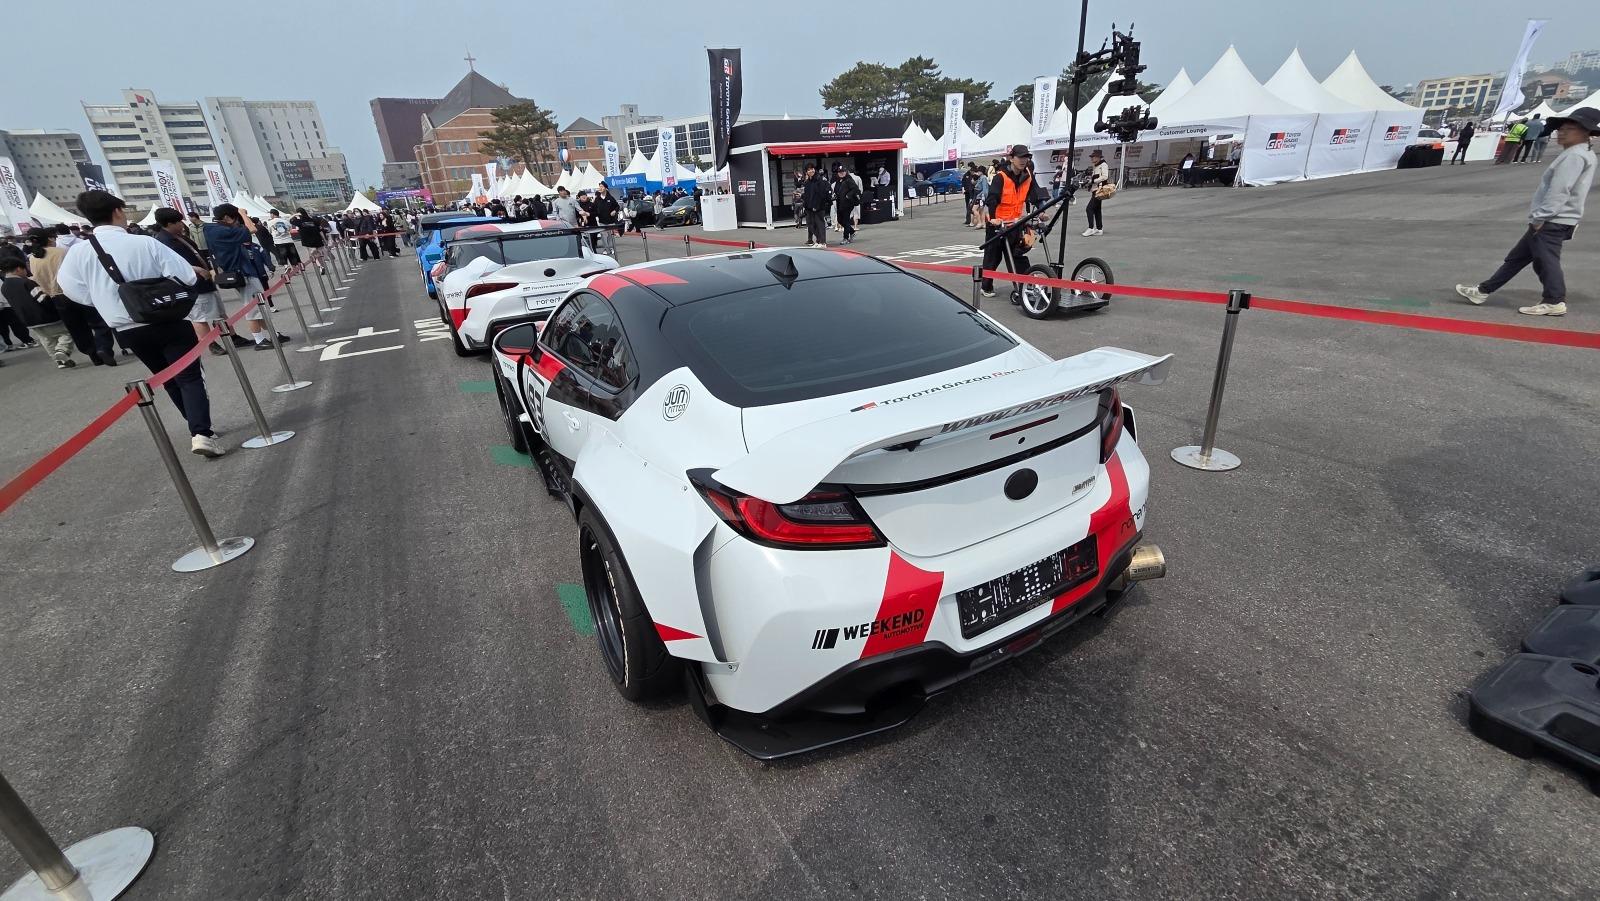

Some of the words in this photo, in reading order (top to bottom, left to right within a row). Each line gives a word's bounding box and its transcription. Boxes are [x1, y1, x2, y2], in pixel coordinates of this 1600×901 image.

[820, 126, 836, 134] GR
[1159, 129, 1186, 137] Customer
[1186, 127, 1208, 135] Lounge
[1331, 135, 1345, 144] GR
[1384, 131, 1398, 140] GR
[1266, 140, 1284, 149] GR
[662, 141, 671, 173] DAEWOO
[880, 387, 941, 406] TOYOTA
[942, 375, 992, 390] GAZOO
[843, 609, 925, 640] WEEKEND
[883, 623, 924, 640] AUTOMOTIVE
